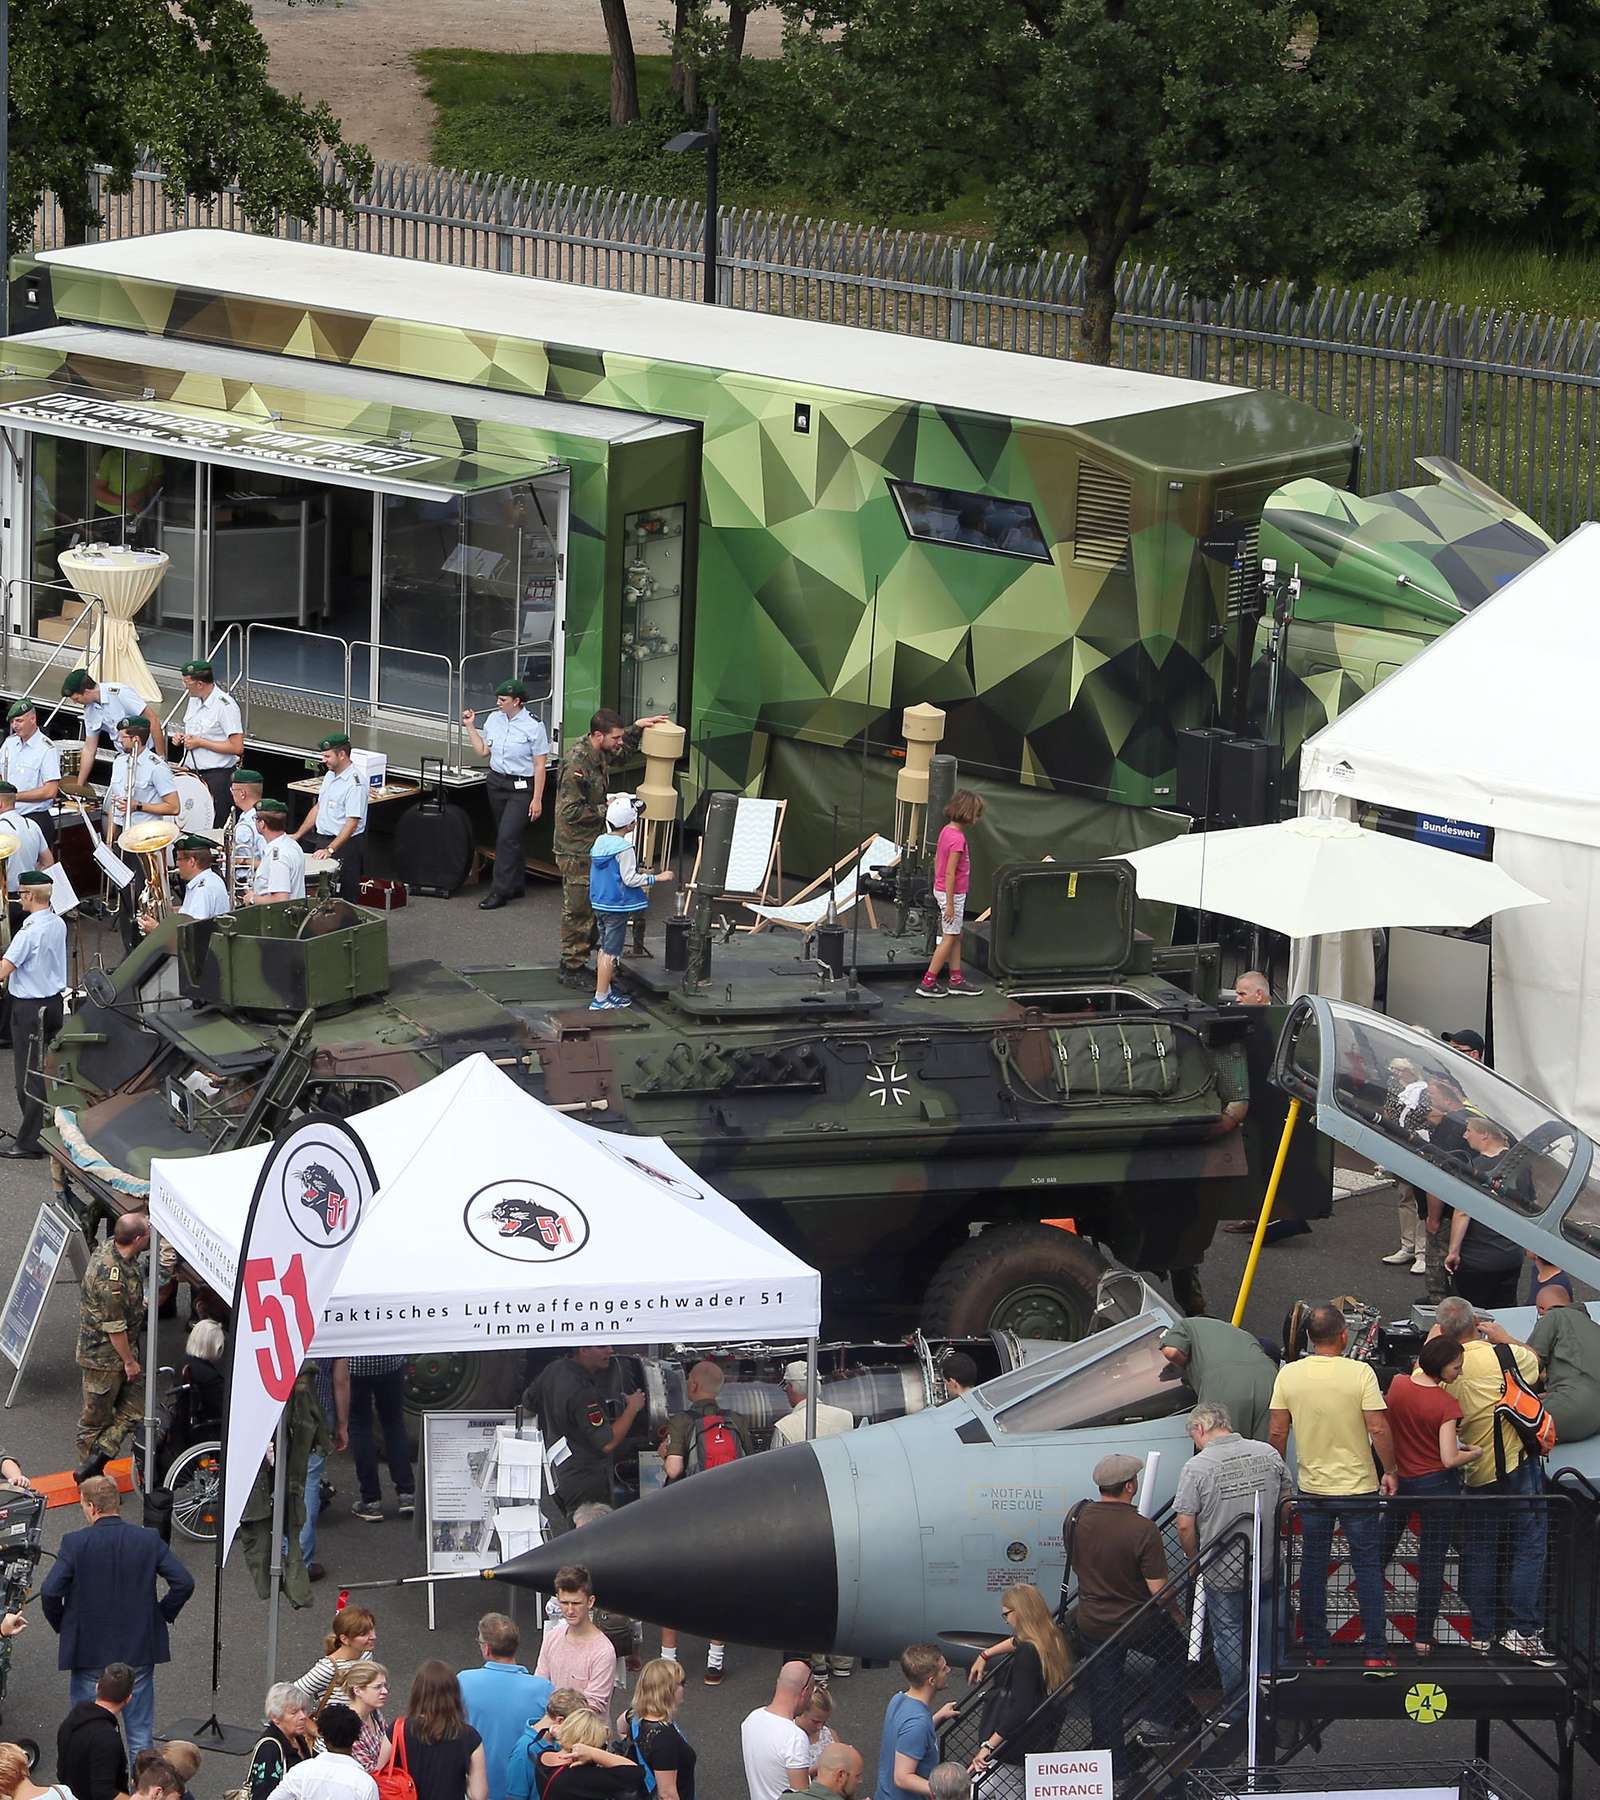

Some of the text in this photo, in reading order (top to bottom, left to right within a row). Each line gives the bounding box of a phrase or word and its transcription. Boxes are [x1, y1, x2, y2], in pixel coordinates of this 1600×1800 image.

[242, 432, 314, 449] UM
[303, 444, 416, 466] DEINE
[1422, 820, 1481, 839] Bundeswehr
[326, 1191, 349, 1231] 51
[536, 1216, 576, 1245] 51
[324, 1291, 784, 1322] Taktisches Luftwaffengeschwader 51
[244, 1253, 315, 1402] 51
[991, 1488, 1044, 1500] NOTFALL
[991, 1500, 1043, 1511] RESCUE
[1420, 1695, 1432, 1710] 4
[1038, 1762, 1098, 1775] EINGANG
[1034, 1784, 1103, 1797] ENTRANCE
